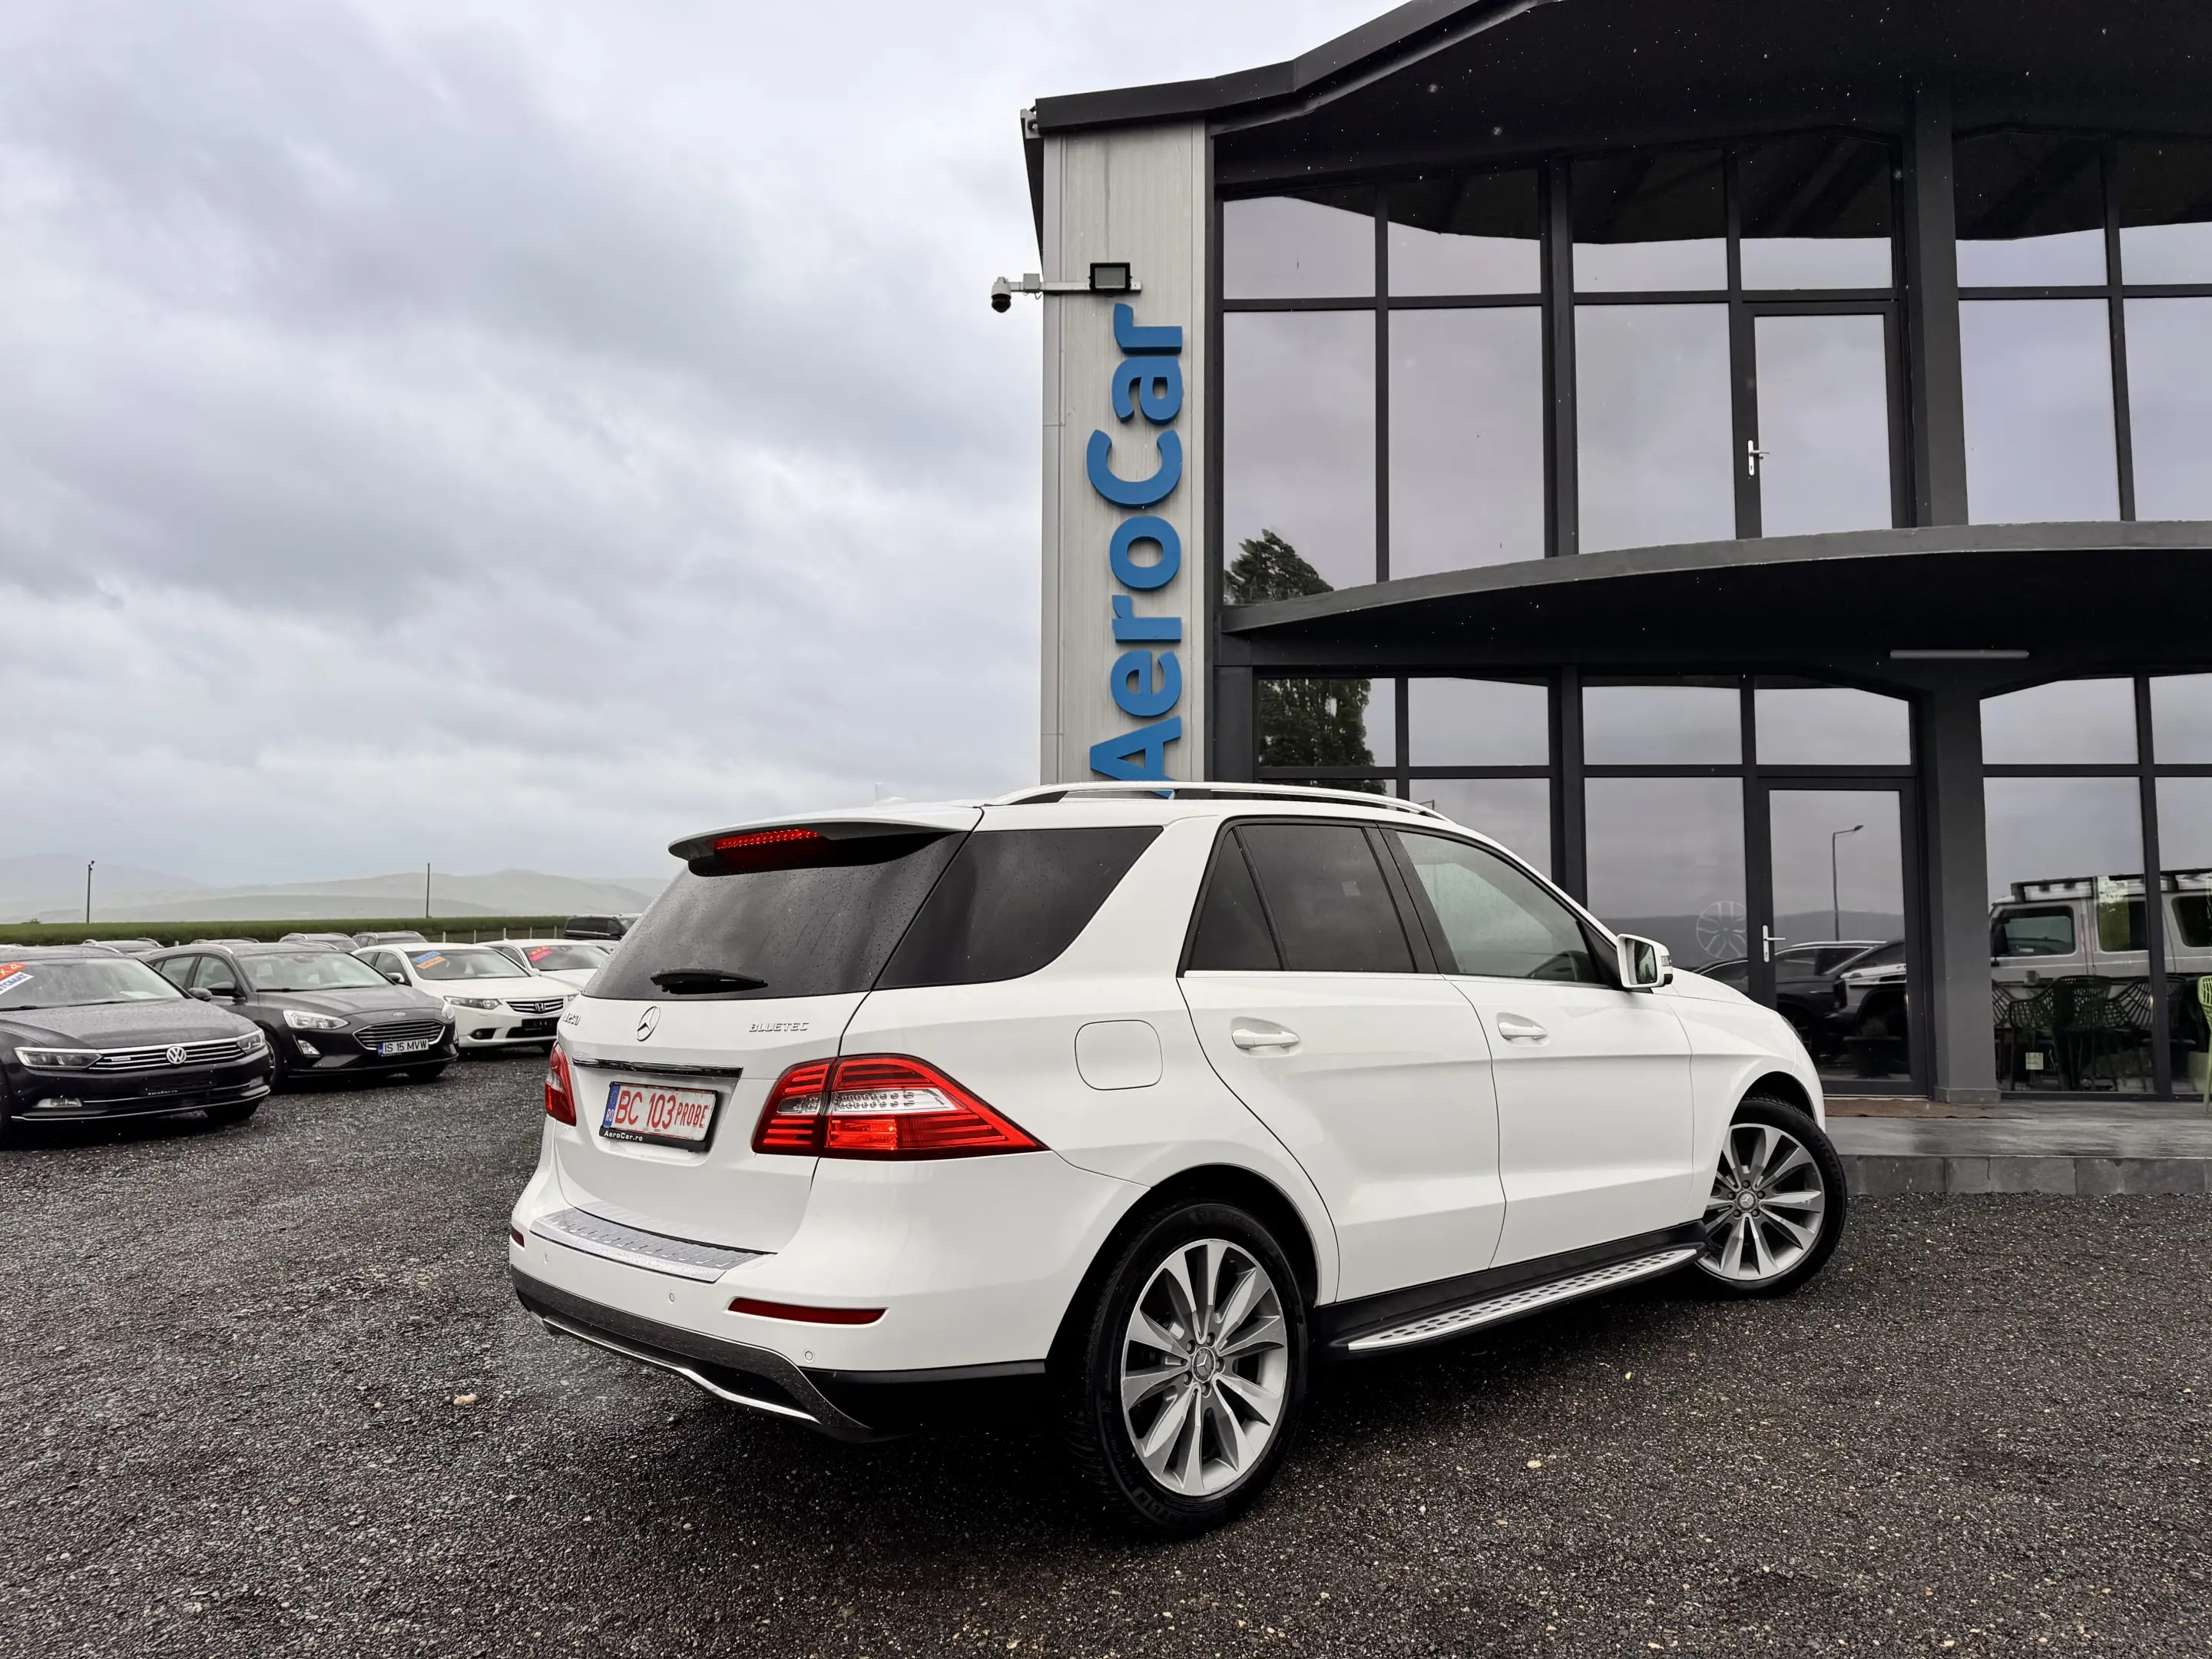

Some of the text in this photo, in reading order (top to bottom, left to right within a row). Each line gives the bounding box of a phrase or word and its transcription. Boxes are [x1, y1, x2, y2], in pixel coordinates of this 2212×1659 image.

[1087, 303, 1184, 800] AeroCar
[750, 1022, 810, 1033] BLUETEC
[385, 1043, 393, 1053] IS
[396, 1042, 405, 1051] 15
[407, 1040, 427, 1051] MVW
[614, 1091, 710, 1130] BC 103 PROBE
[604, 1131, 643, 1142] AeroCar.ro
